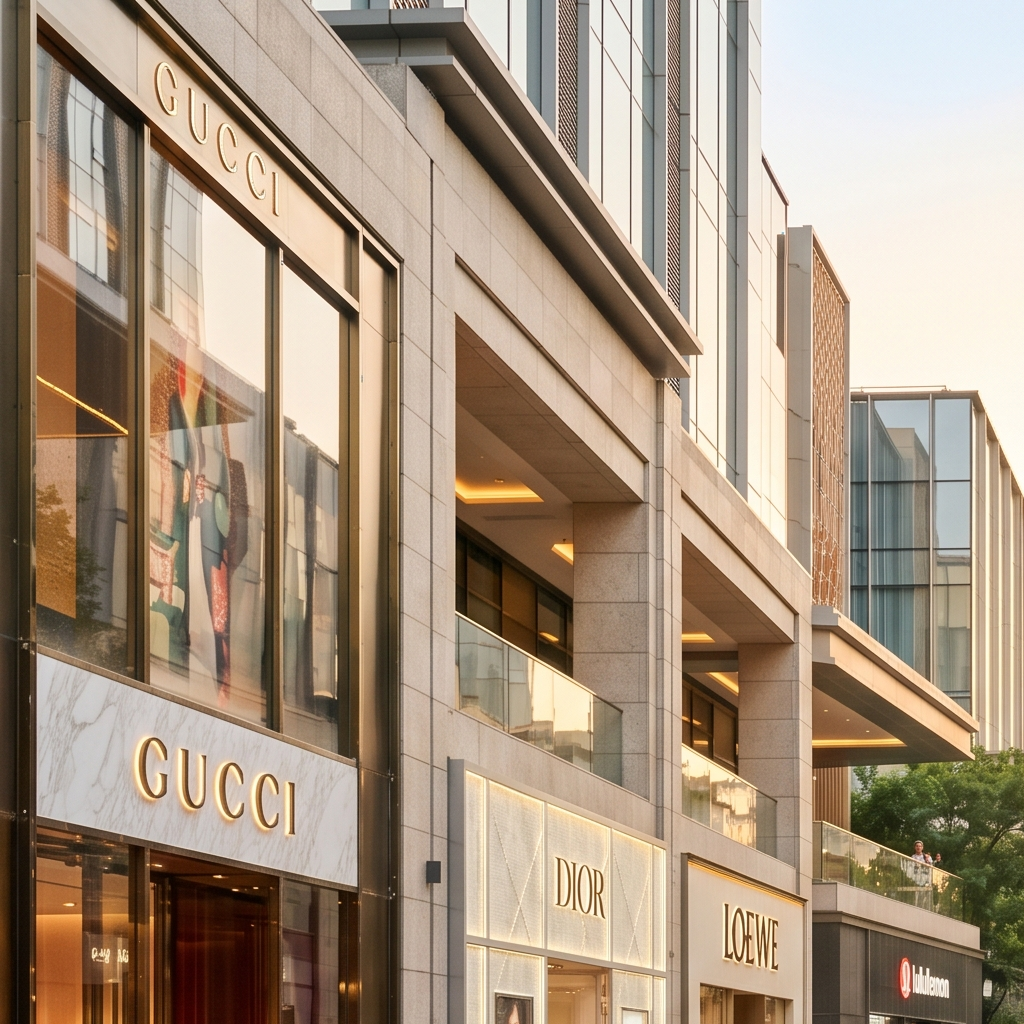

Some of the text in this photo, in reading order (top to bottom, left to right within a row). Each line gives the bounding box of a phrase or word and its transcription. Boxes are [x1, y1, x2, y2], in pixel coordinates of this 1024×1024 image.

[154, 61, 280, 217] GUCCI
[136, 736, 296, 836] GUCCI
[555, 856, 606, 919] DIOR
[723, 903, 779, 971] LOEWE
